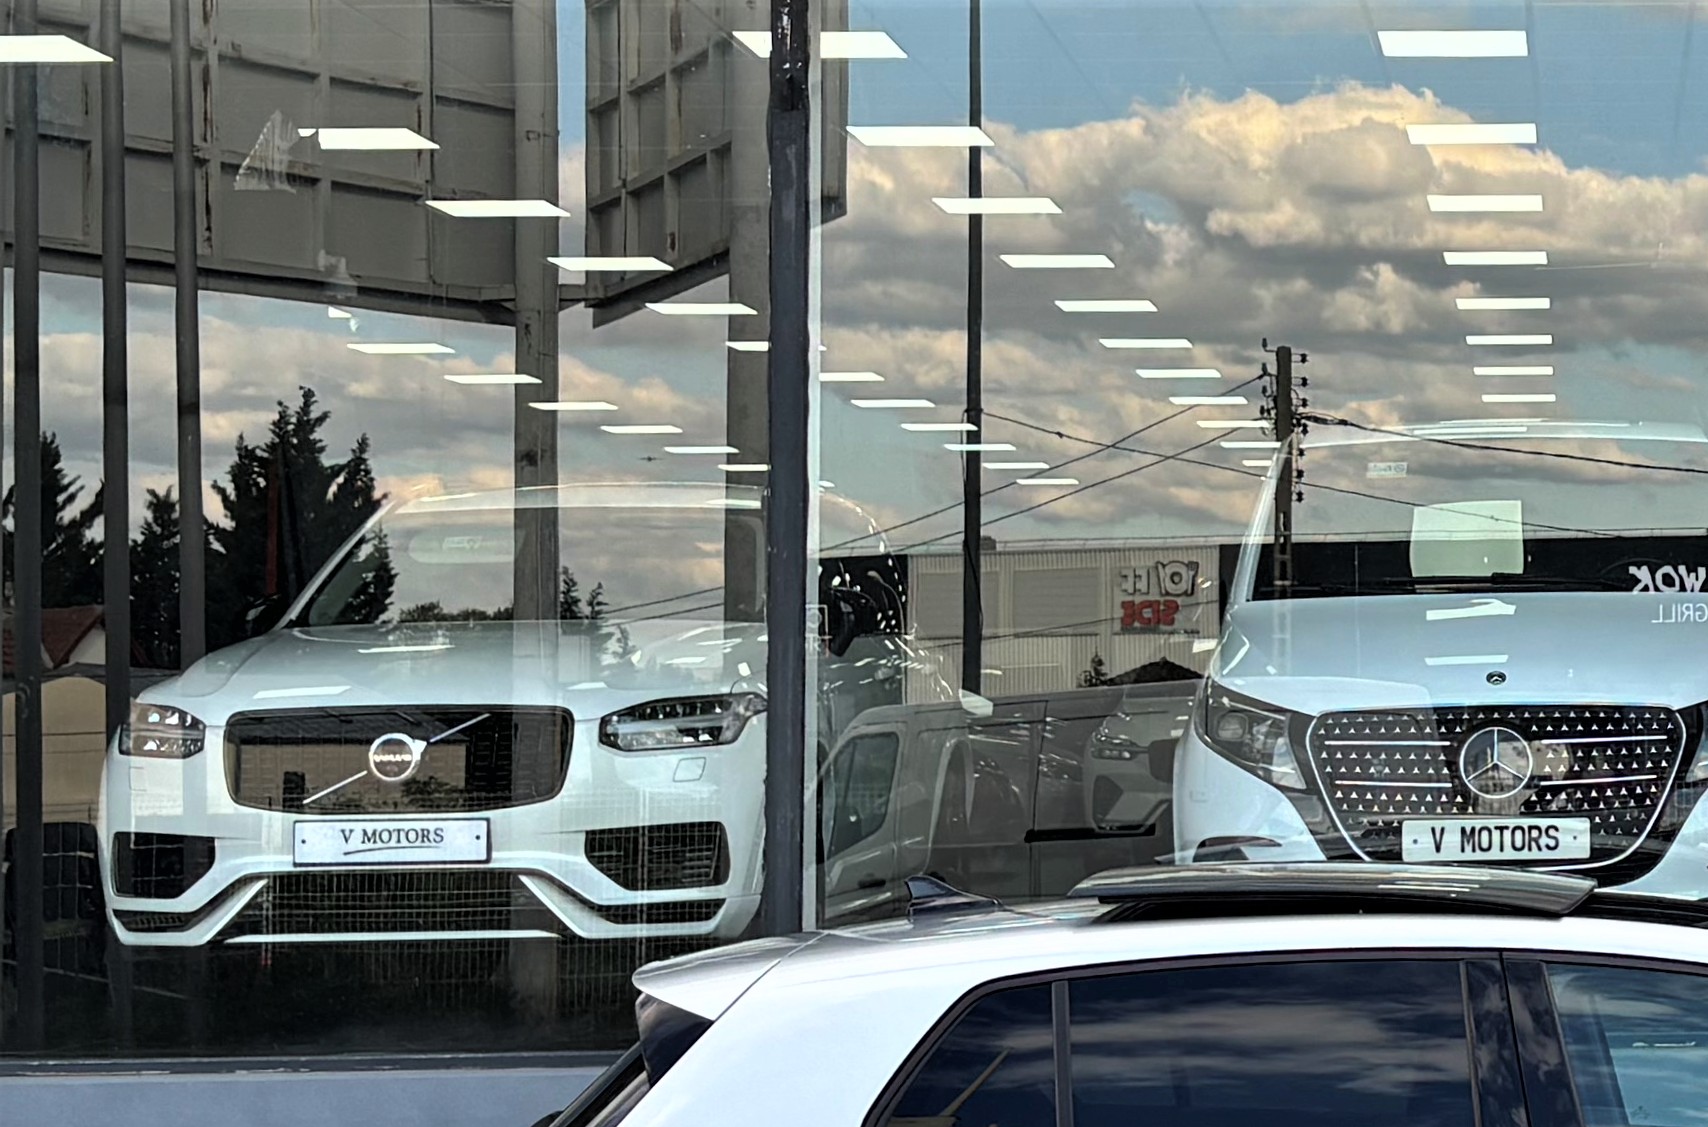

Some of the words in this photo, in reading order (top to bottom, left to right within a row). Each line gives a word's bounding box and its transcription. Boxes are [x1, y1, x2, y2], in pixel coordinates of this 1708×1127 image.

[341, 828, 355, 845] V
[360, 827, 444, 846] MOTORS
[1431, 827, 1443, 854] V
[1460, 825, 1560, 853] MOTORS
